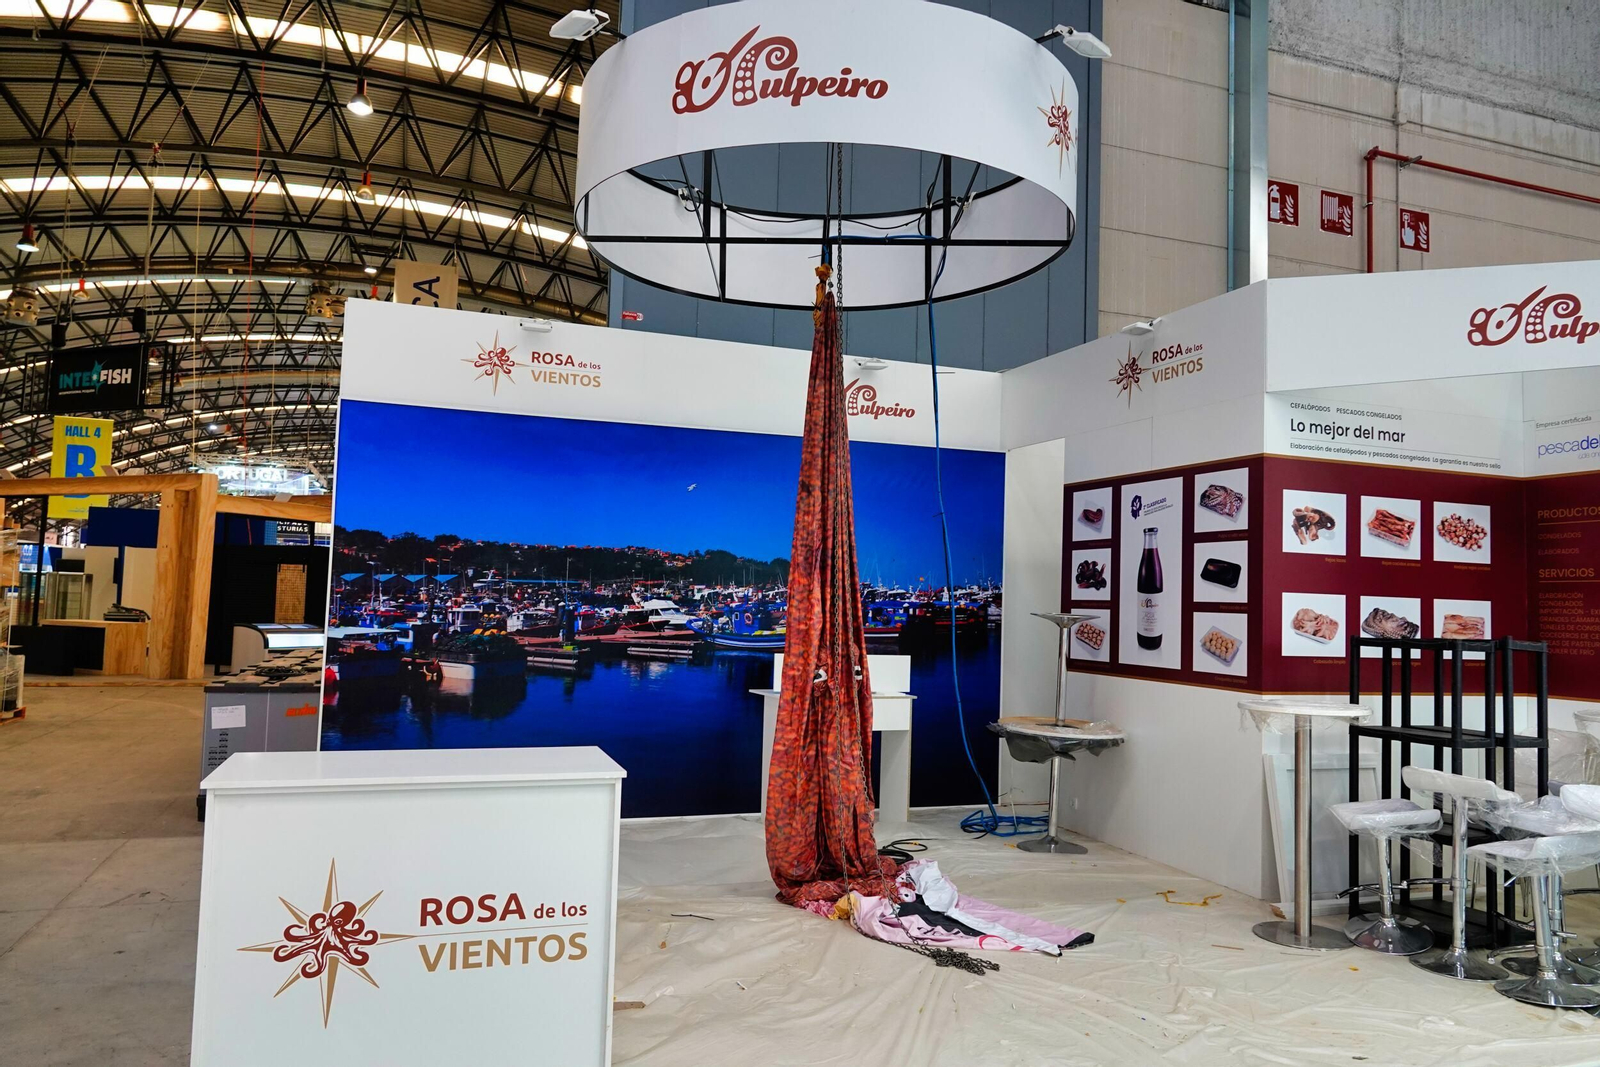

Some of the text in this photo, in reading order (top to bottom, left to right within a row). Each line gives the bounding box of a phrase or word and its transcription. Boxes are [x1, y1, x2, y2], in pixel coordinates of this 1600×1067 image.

[1525, 293, 1600, 344] Pulp
[532, 351, 575, 367] ROSA
[590, 362, 601, 370] los
[1152, 344, 1183, 364] ROSA
[1194, 344, 1202, 352] los
[531, 370, 601, 388] VIENTOS
[1152, 358, 1203, 383] VIENTOS
[1290, 402, 1330, 412] CEFALÓPODOS
[1336, 408, 1402, 420] PESCADOS CONGELADOS
[1561, 415, 1591, 424] certificada
[65, 425, 101, 438] HALL 4
[1291, 419, 1405, 442] Lo mejor del mar
[1290, 443, 1324, 451] Elaboración
[1333, 447, 1367, 456] cefalópodos
[1539, 568, 1594, 577] SERVICIOS
[420, 893, 587, 927] ROSA de los
[418, 932, 588, 972] VIENTOS
